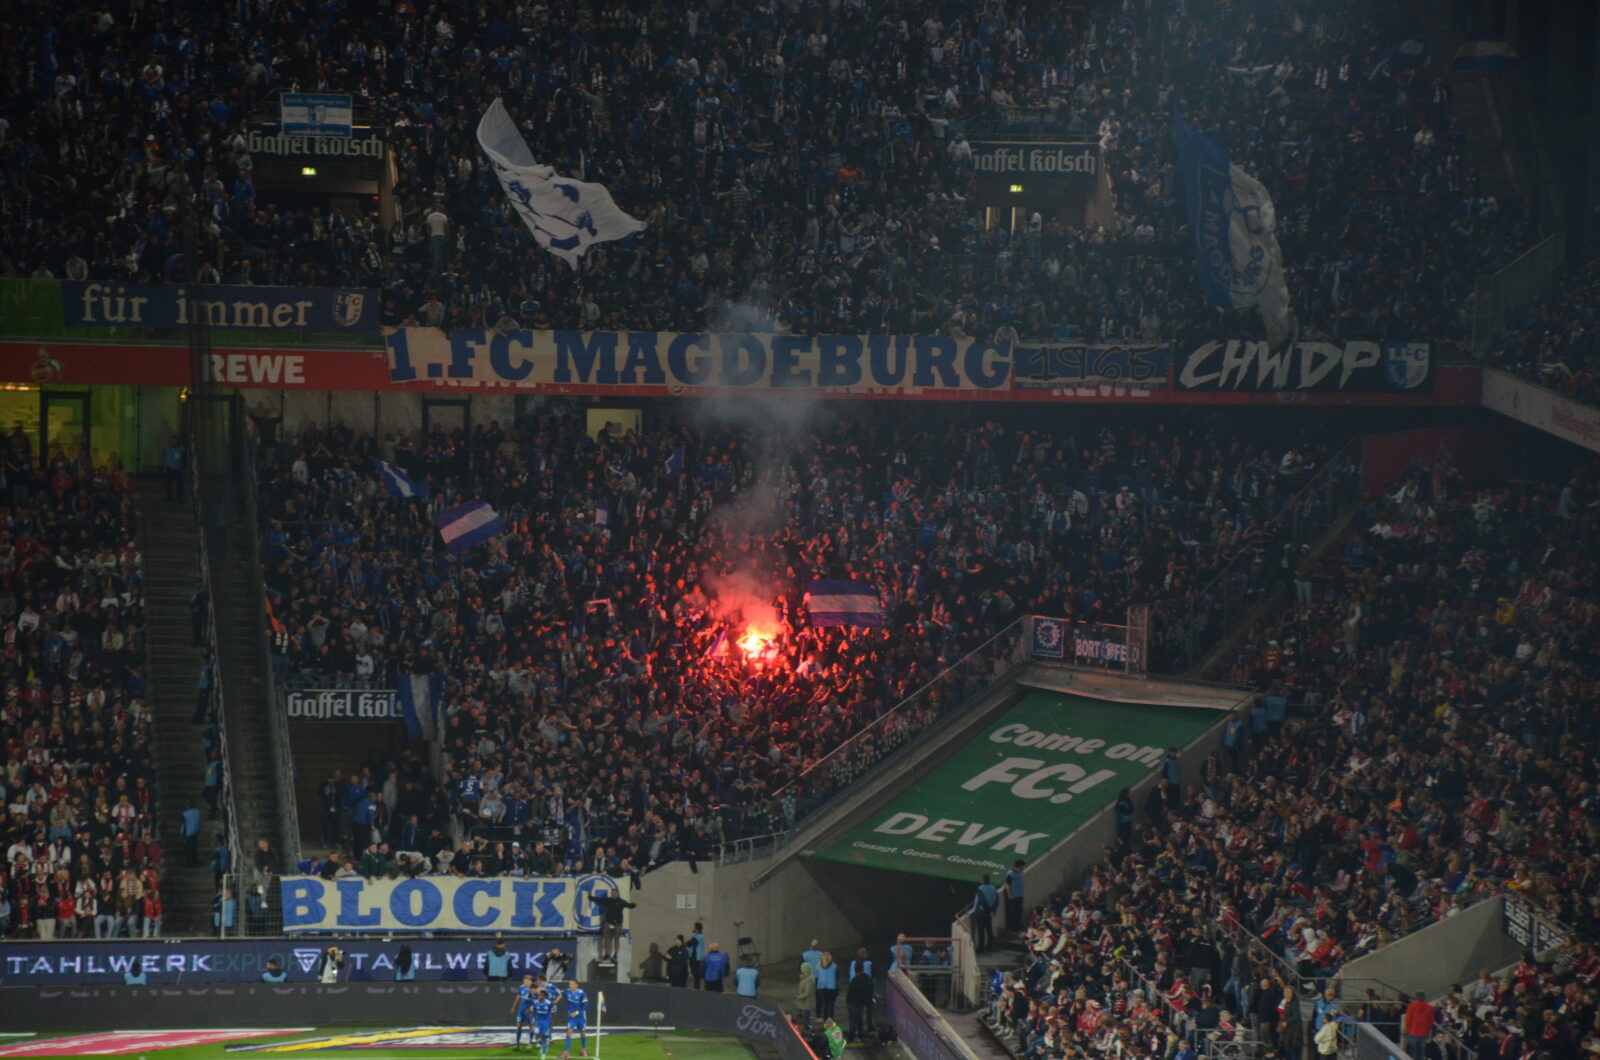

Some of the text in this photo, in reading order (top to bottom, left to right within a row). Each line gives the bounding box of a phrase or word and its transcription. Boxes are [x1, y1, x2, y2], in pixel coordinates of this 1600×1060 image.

[1030, 148, 1096, 176] Kölsch
[80, 284, 313, 328] für immer
[201, 353, 306, 384] REWE
[553, 330, 1014, 389] MAGDEBURG
[1028, 345, 1159, 382] 1965
[1179, 339, 1382, 390] CHWDP
[1076, 638, 1101, 658] BORT
[287, 692, 355, 719] Gaffel
[988, 722, 1107, 756] Come
[960, 757, 1118, 804] FC!
[872, 811, 1052, 856] DEVK
[281, 878, 566, 928] BLOCK
[6, 954, 213, 975] TAHLWERK
[348, 951, 545, 970] TALWERK
